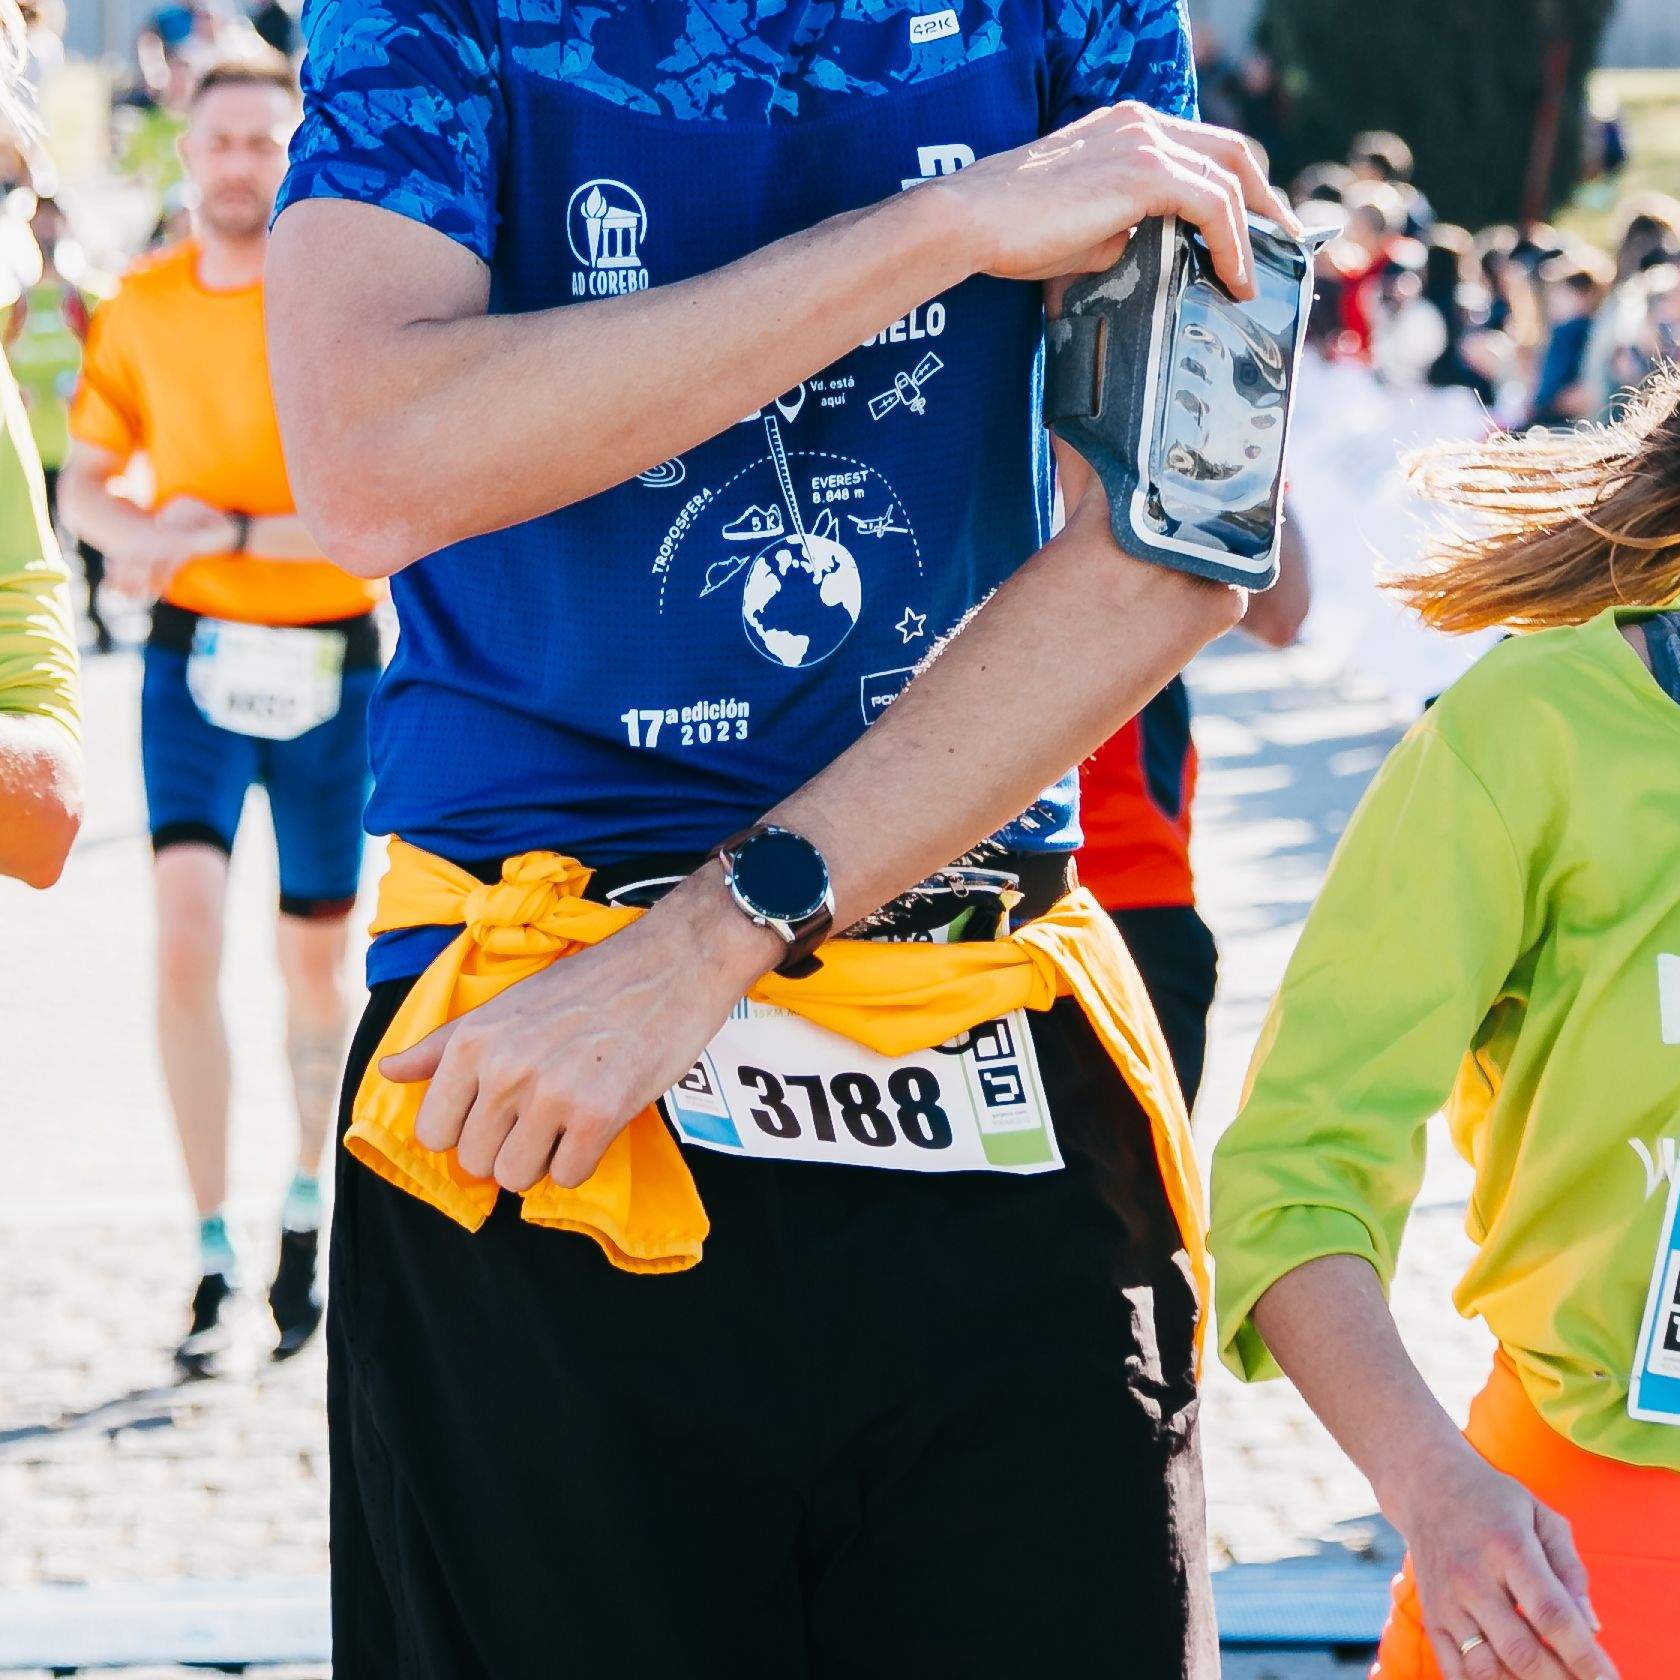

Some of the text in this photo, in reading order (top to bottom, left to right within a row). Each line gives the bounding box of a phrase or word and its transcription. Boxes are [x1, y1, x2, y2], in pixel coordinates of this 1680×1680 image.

[572, 268, 649, 296] AD COREBO
[829, 375, 855, 390] está
[820, 393, 847, 408] aquí
[811, 469, 870, 490] EVEREST
[812, 487, 851, 504] 8.848
[651, 486, 712, 575] TROPOSFERA
[681, 698, 751, 722] edición
[680, 719, 749, 746] 2023
[736, 1064, 954, 1151] 3788
